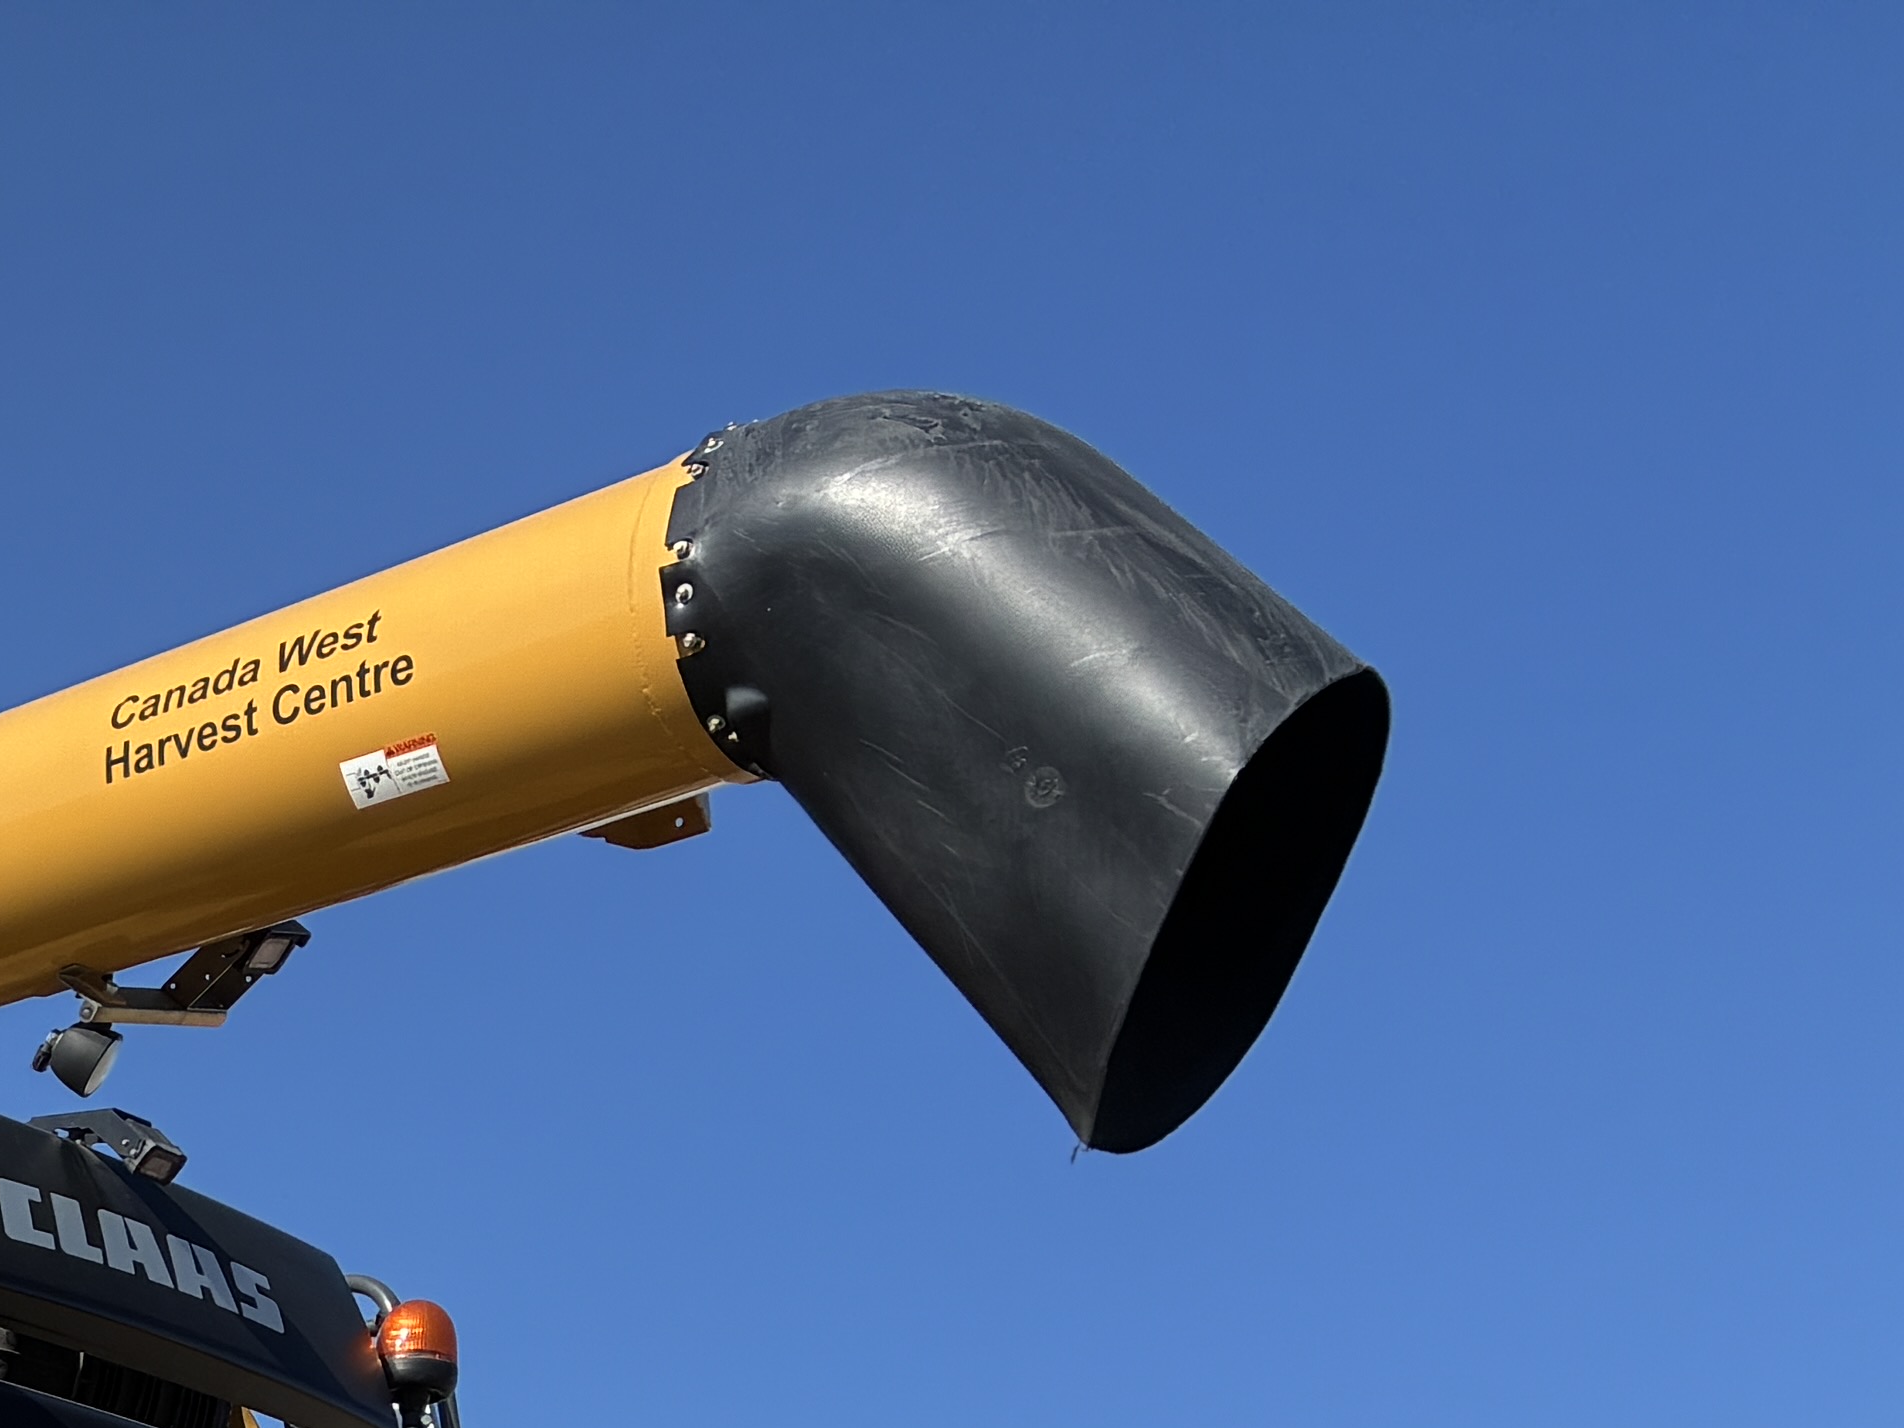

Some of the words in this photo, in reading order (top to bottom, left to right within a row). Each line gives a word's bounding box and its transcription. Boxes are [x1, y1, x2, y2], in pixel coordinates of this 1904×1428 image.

[105, 698, 259, 784] Harvest
[271, 653, 414, 725] Centre
[110, 657, 261, 730] Canada
[277, 608, 382, 674] West
